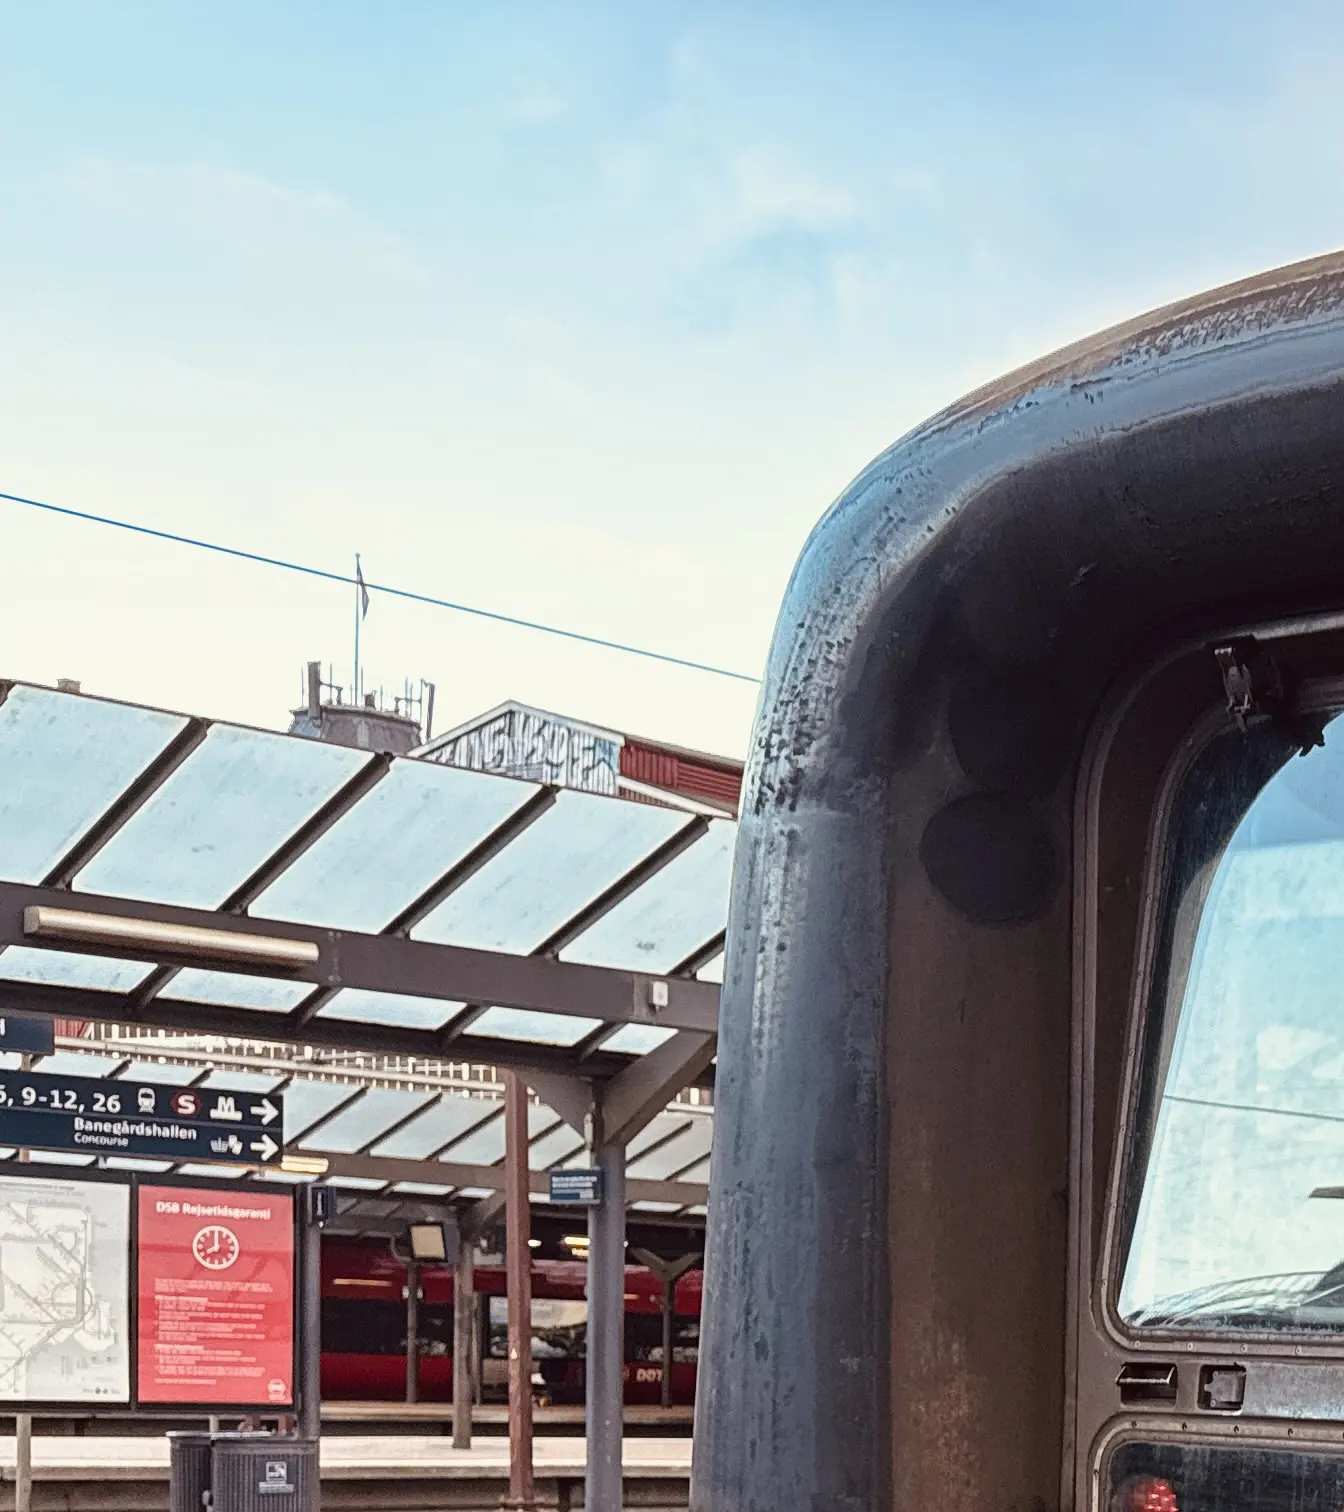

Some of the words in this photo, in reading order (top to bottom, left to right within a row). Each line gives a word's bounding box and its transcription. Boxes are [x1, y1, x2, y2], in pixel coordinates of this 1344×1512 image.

[21, 1086, 85, 1113] 9-12,
[92, 1092, 121, 1114] 26
[73, 1117, 197, 1140] Banegårdshallen
[73, 1132, 129, 1147] Concourse
[156, 1201, 180, 1214] DSB
